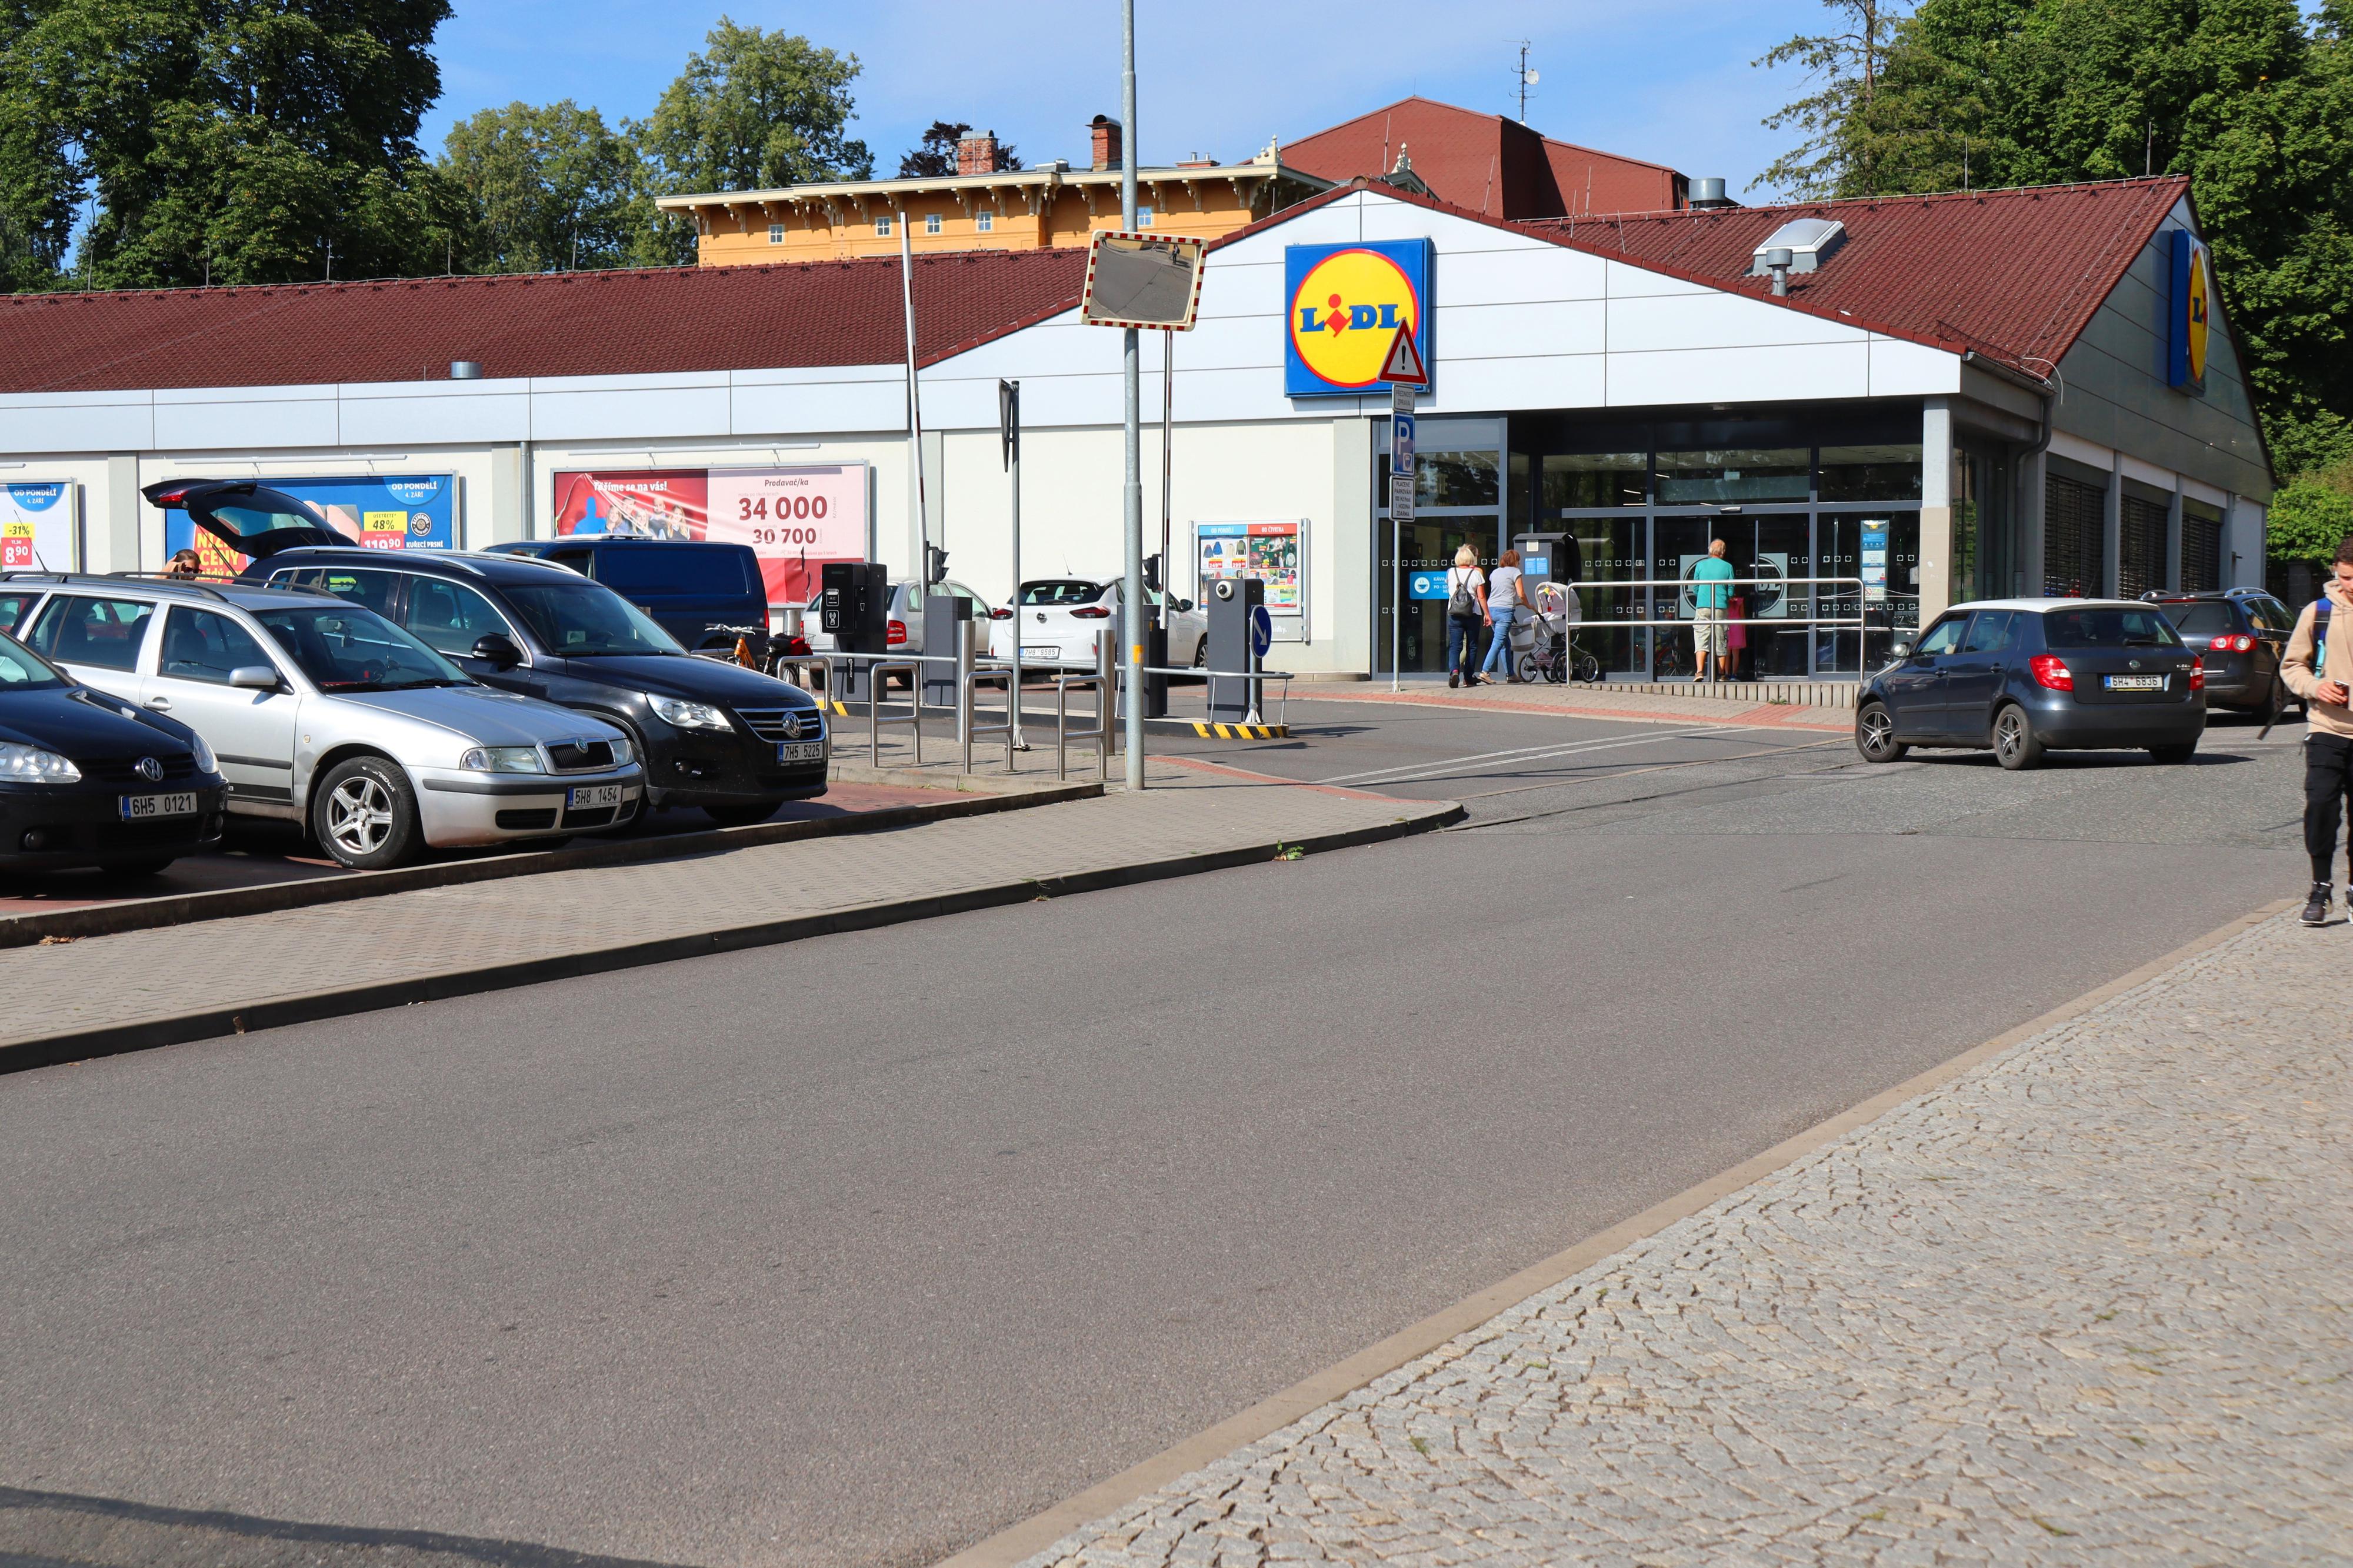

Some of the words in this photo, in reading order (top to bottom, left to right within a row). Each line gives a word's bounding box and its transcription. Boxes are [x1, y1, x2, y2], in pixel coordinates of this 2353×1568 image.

[1398, 421, 1410, 455] P
[404, 481, 437, 490] PONDĚLÍ
[649, 481, 668, 491] vás!
[764, 478, 809, 488] Prodavač/ka
[26, 488, 57, 496] PONDĚLÍ
[739, 498, 768, 521] 34
[775, 496, 828, 520] 000
[373, 520, 395, 530] 48%
[9, 526, 30, 535] -31%
[752, 529, 775, 544] 30
[781, 528, 816, 544] 700
[406, 540, 426, 548] KUŘECÍ
[199, 549, 239, 566] CENY
[2112, 676, 2129, 686] 6H4
[2136, 676, 2158, 686] 6836
[785, 745, 799, 759] 7H5
[804, 744, 820, 758] 5225
[575, 789, 591, 805] 5H8
[598, 787, 617, 803] 1454
[132, 797, 155, 815] 6H5
[165, 795, 191, 813] 0121
